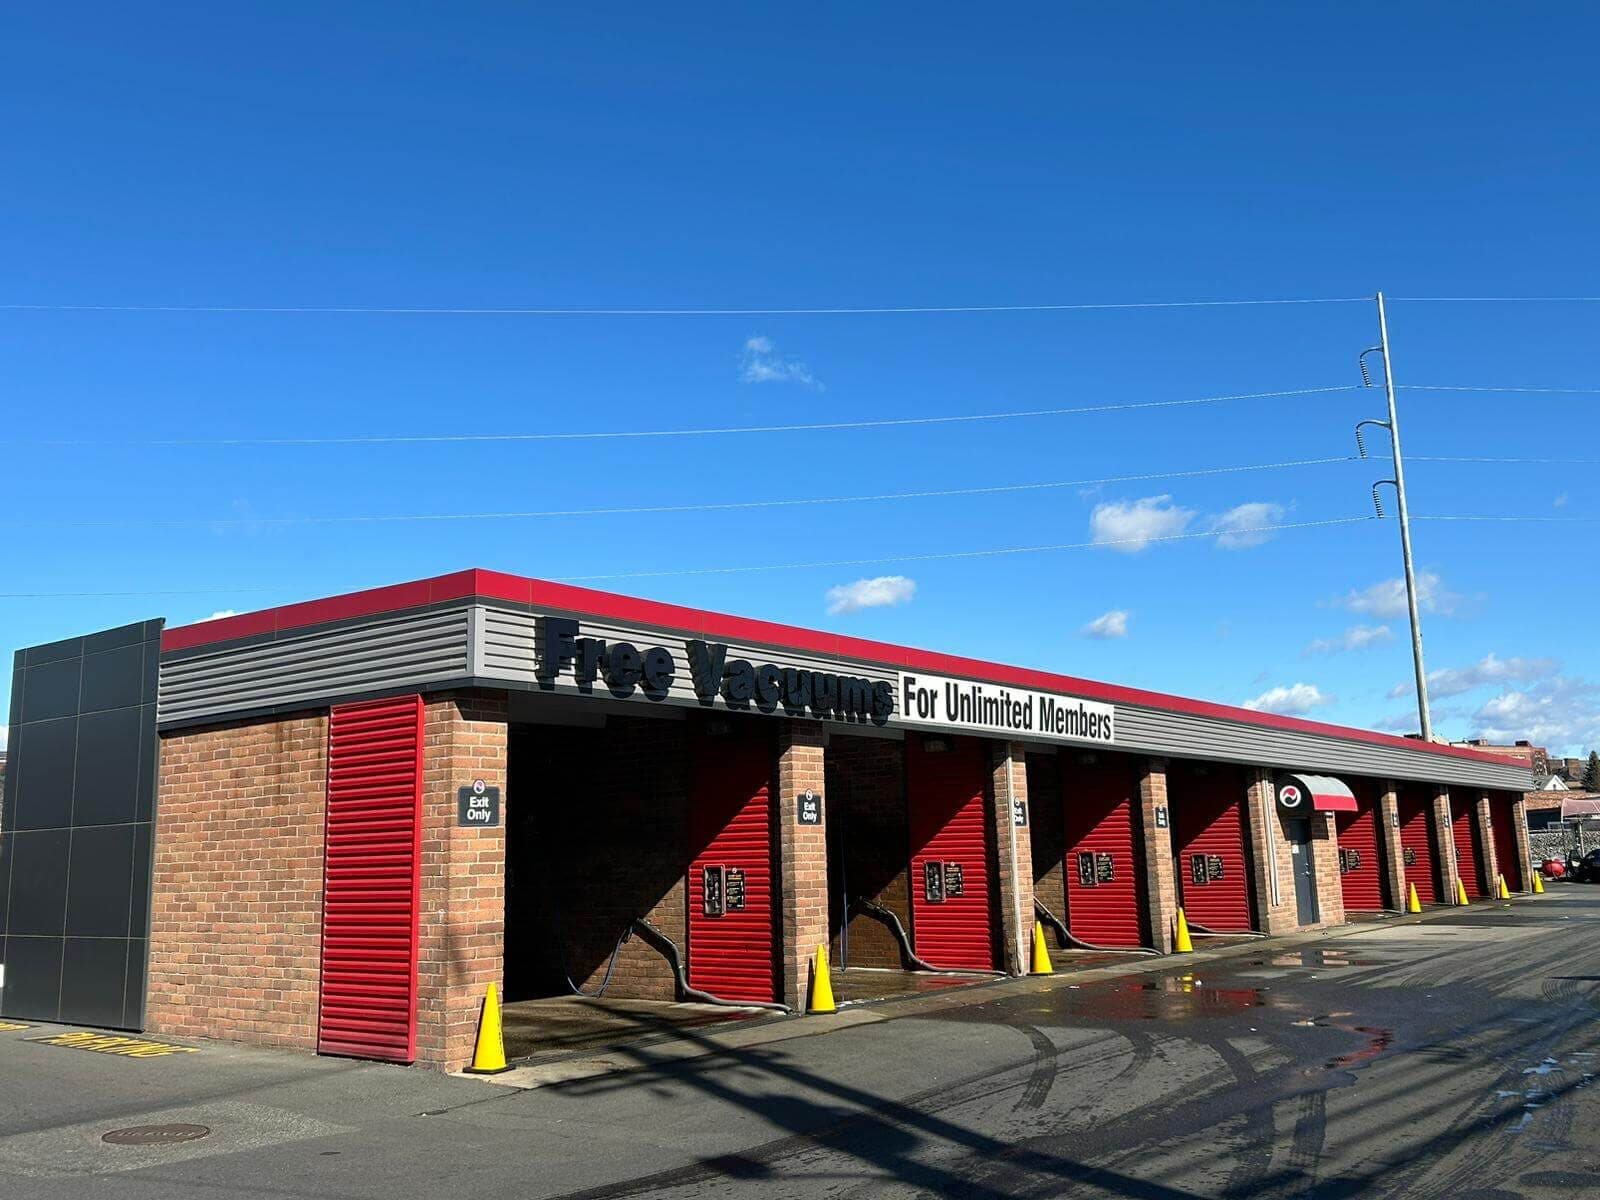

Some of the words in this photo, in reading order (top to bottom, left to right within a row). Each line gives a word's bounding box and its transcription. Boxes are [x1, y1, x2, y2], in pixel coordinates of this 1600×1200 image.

[536, 616, 675, 690] Free
[686, 639, 893, 717] Vacuums
[904, 676, 938, 719] For
[945, 682, 1033, 730] Unlimited
[1039, 696, 1112, 740] Members
[467, 808, 491, 823] Only
[469, 796, 489, 808] Exit
